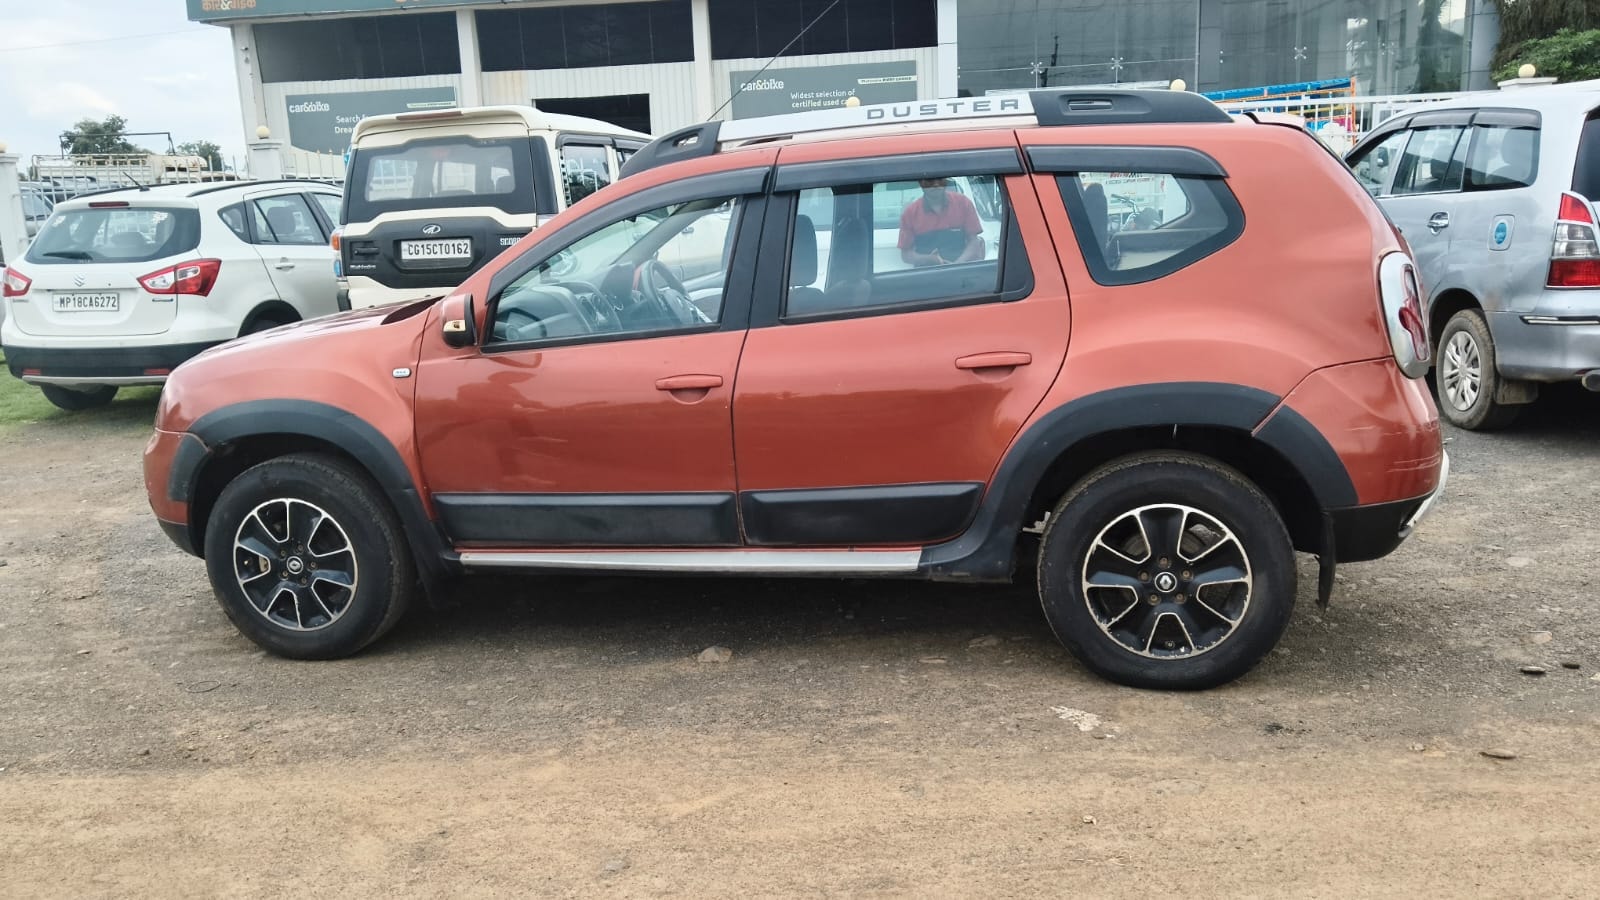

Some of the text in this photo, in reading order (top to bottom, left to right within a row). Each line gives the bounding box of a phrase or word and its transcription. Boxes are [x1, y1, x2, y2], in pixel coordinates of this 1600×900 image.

[741, 79, 785, 91] car&bike
[790, 88, 856, 100] Widest selection of
[289, 101, 330, 113] car&bike
[792, 100, 821, 108] certified
[823, 99, 840, 107] used
[867, 99, 1019, 120] DUSTER
[335, 114, 361, 124] Search
[334, 126, 353, 134] Drea
[408, 242, 469, 256] CG15CT0162
[59, 296, 117, 309] MP18CA6272
